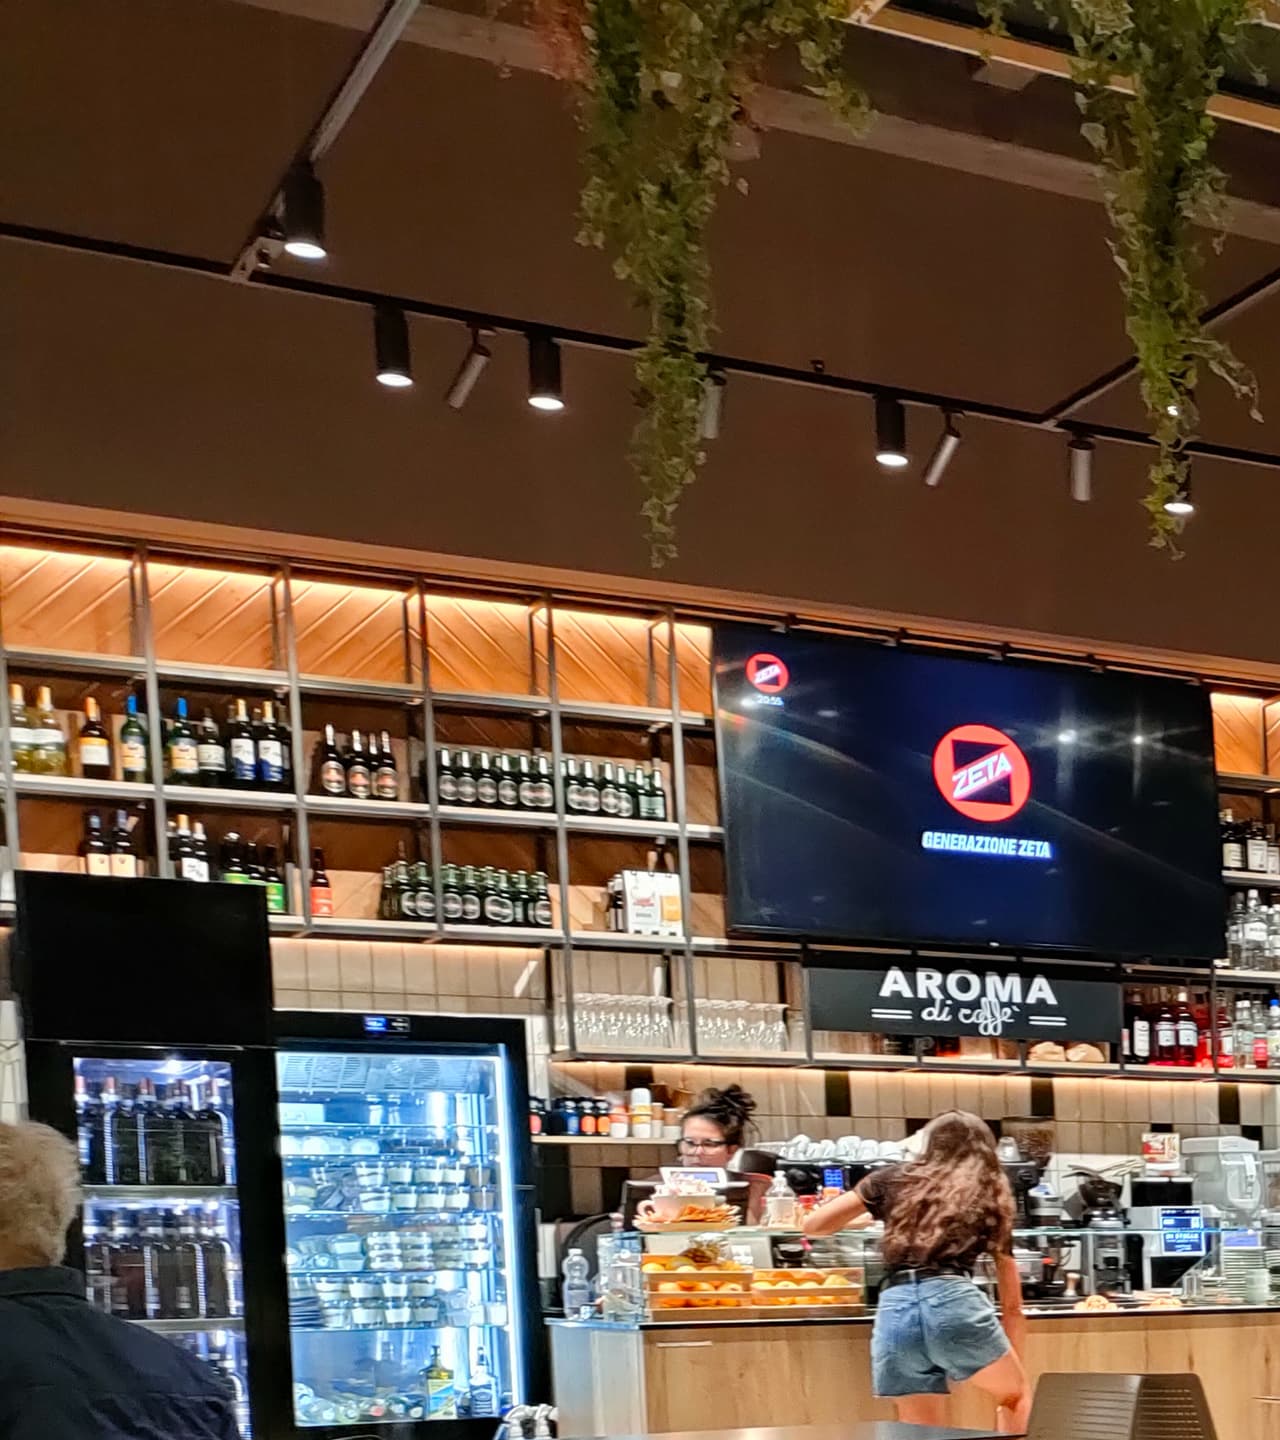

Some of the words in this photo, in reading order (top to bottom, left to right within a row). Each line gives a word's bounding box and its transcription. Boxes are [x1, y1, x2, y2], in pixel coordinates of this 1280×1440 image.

[952, 752, 1013, 799] ZETA
[921, 831, 1018, 855] GENERAZIONE
[1018, 841, 1052, 859] ZETA
[879, 966, 1058, 1004] AROMA
[920, 994, 953, 1021] di
